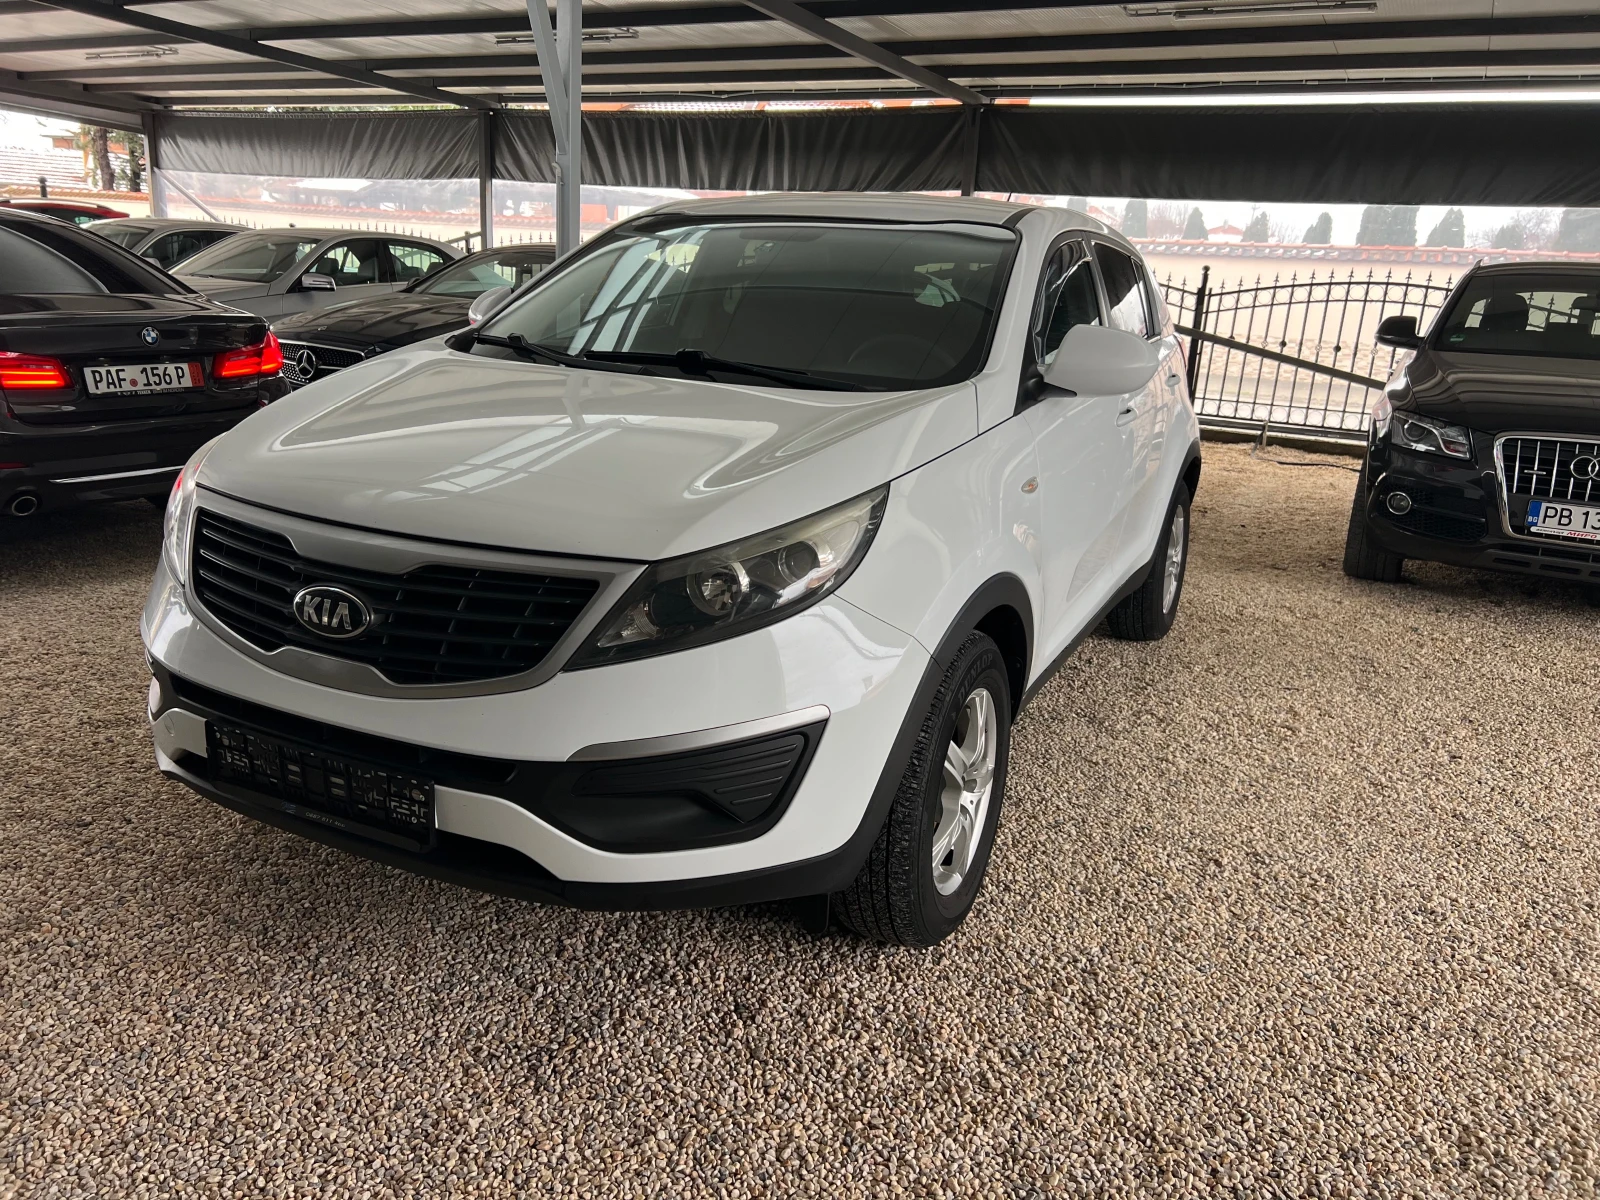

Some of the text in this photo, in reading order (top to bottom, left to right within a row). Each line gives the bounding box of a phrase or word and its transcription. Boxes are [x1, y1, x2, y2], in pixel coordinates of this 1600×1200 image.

[90, 368, 127, 391] PAF
[140, 366, 173, 388] 156
[176, 365, 185, 385] P
[1527, 515, 1538, 523] BG
[1542, 505, 1573, 527] PB
[303, 594, 353, 631] KIA
[958, 653, 993, 706] DUNLOP
